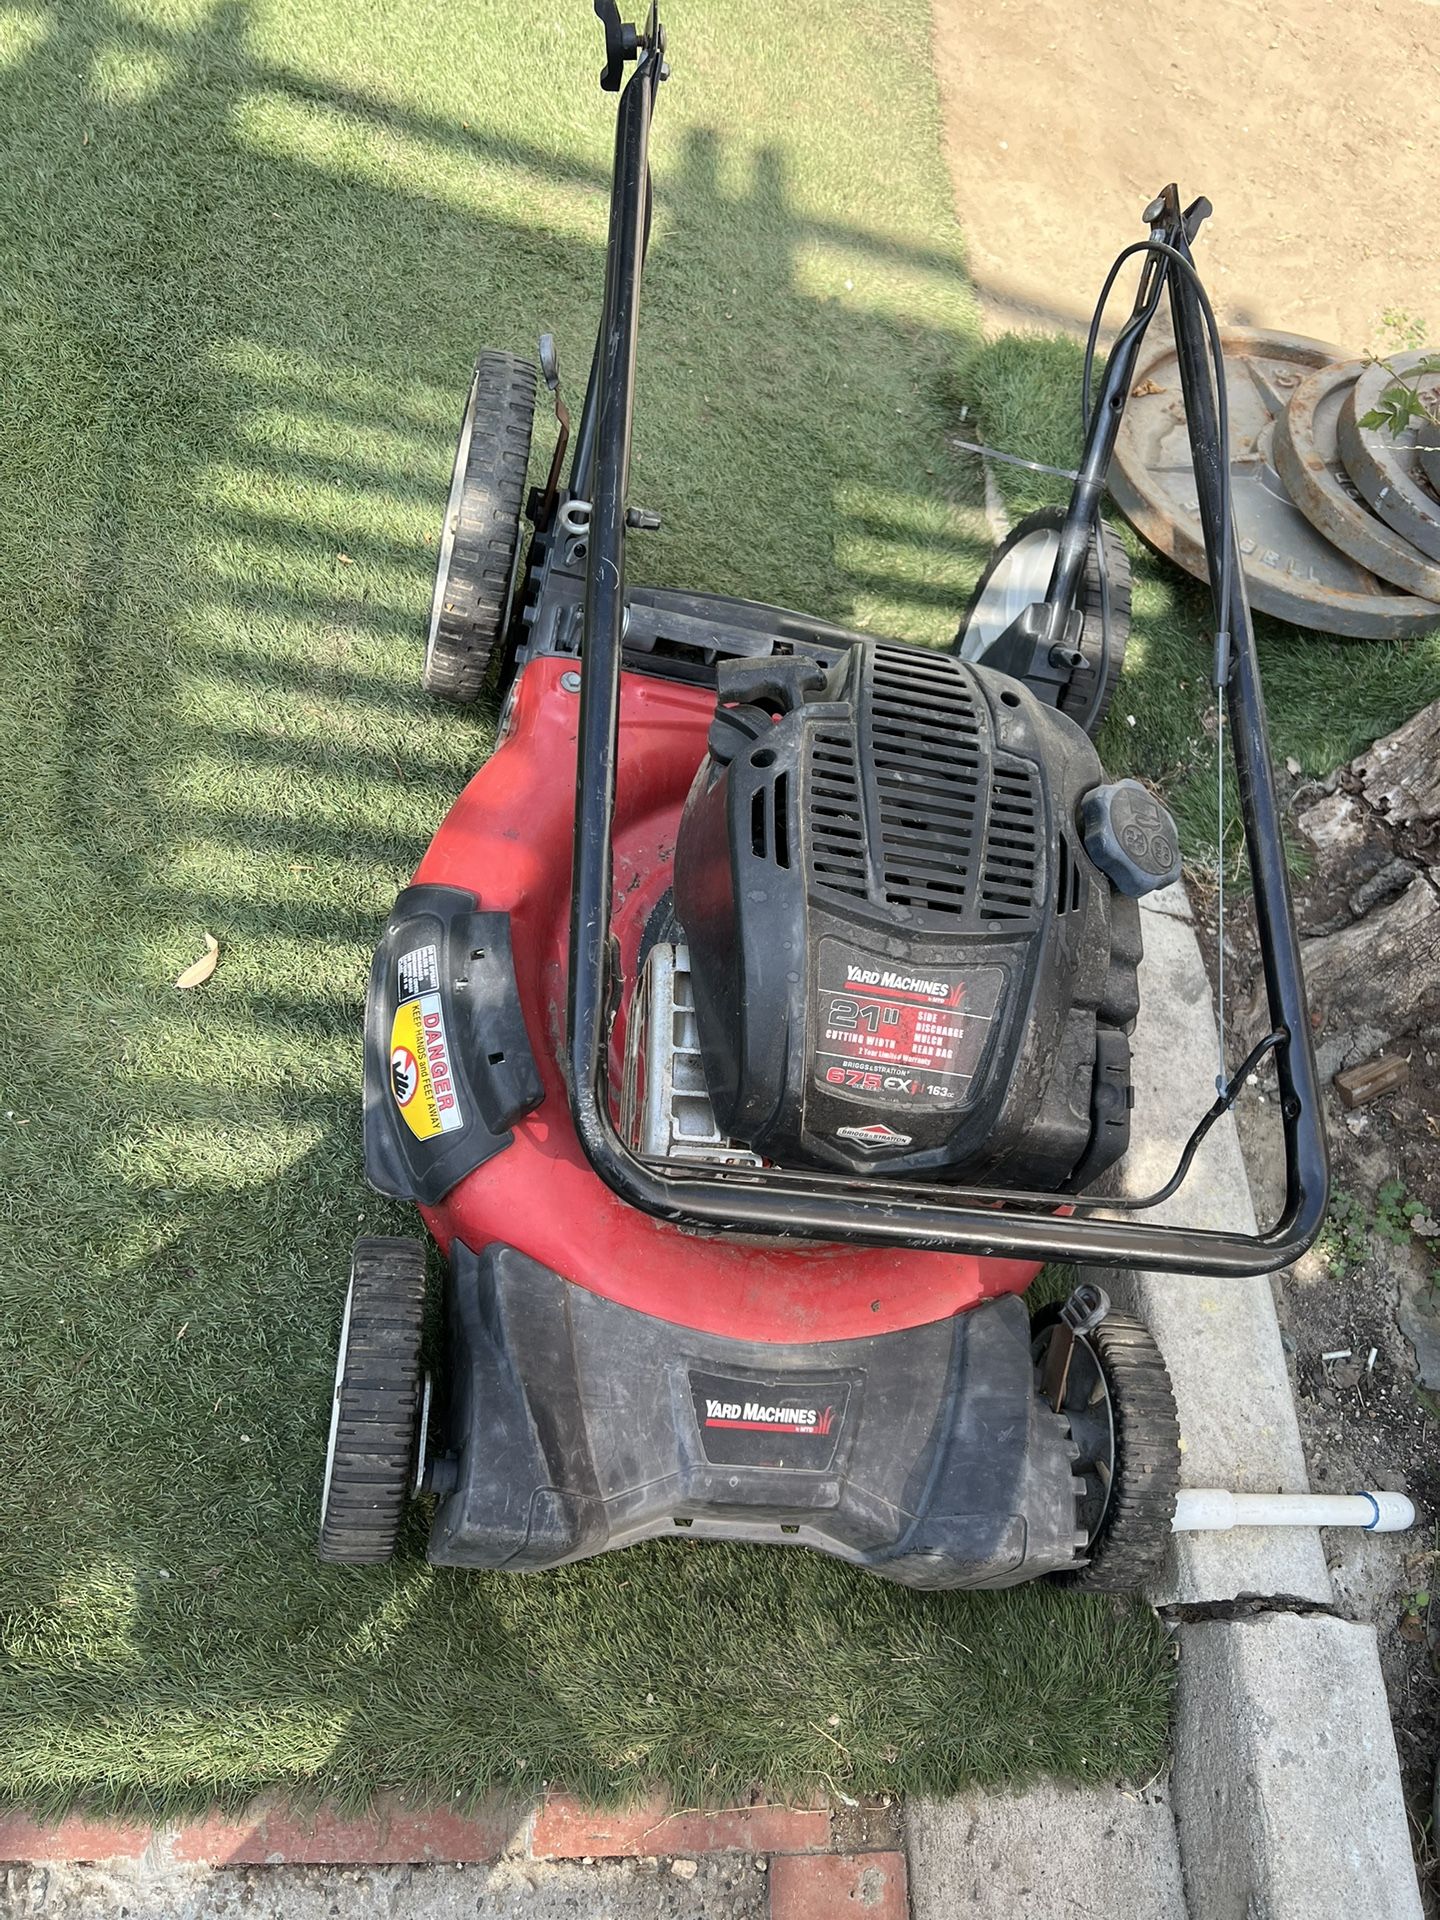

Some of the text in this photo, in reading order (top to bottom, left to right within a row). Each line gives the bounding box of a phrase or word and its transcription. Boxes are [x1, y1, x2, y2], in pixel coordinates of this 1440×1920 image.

[847, 965, 950, 997] YARD MACHINES
[917, 1011, 938, 1023] SIDE
[825, 1029, 897, 1050] CUTTING WIDTH
[913, 1034, 944, 1047] MULCH
[915, 1023, 964, 1039] DISCHARGE
[423, 1012, 455, 1112] DANGER
[864, 1050, 877, 1058] Year
[877, 1051, 901, 1062] Limited
[902, 1054, 932, 1067] Warranty
[912, 1044, 954, 1060] REAR BAG
[411, 1004, 440, 1130] KEEP HANDS and FEET AWAY
[825, 1066, 882, 1088] 675
[705, 1399, 817, 1425] YARD MACHINES
